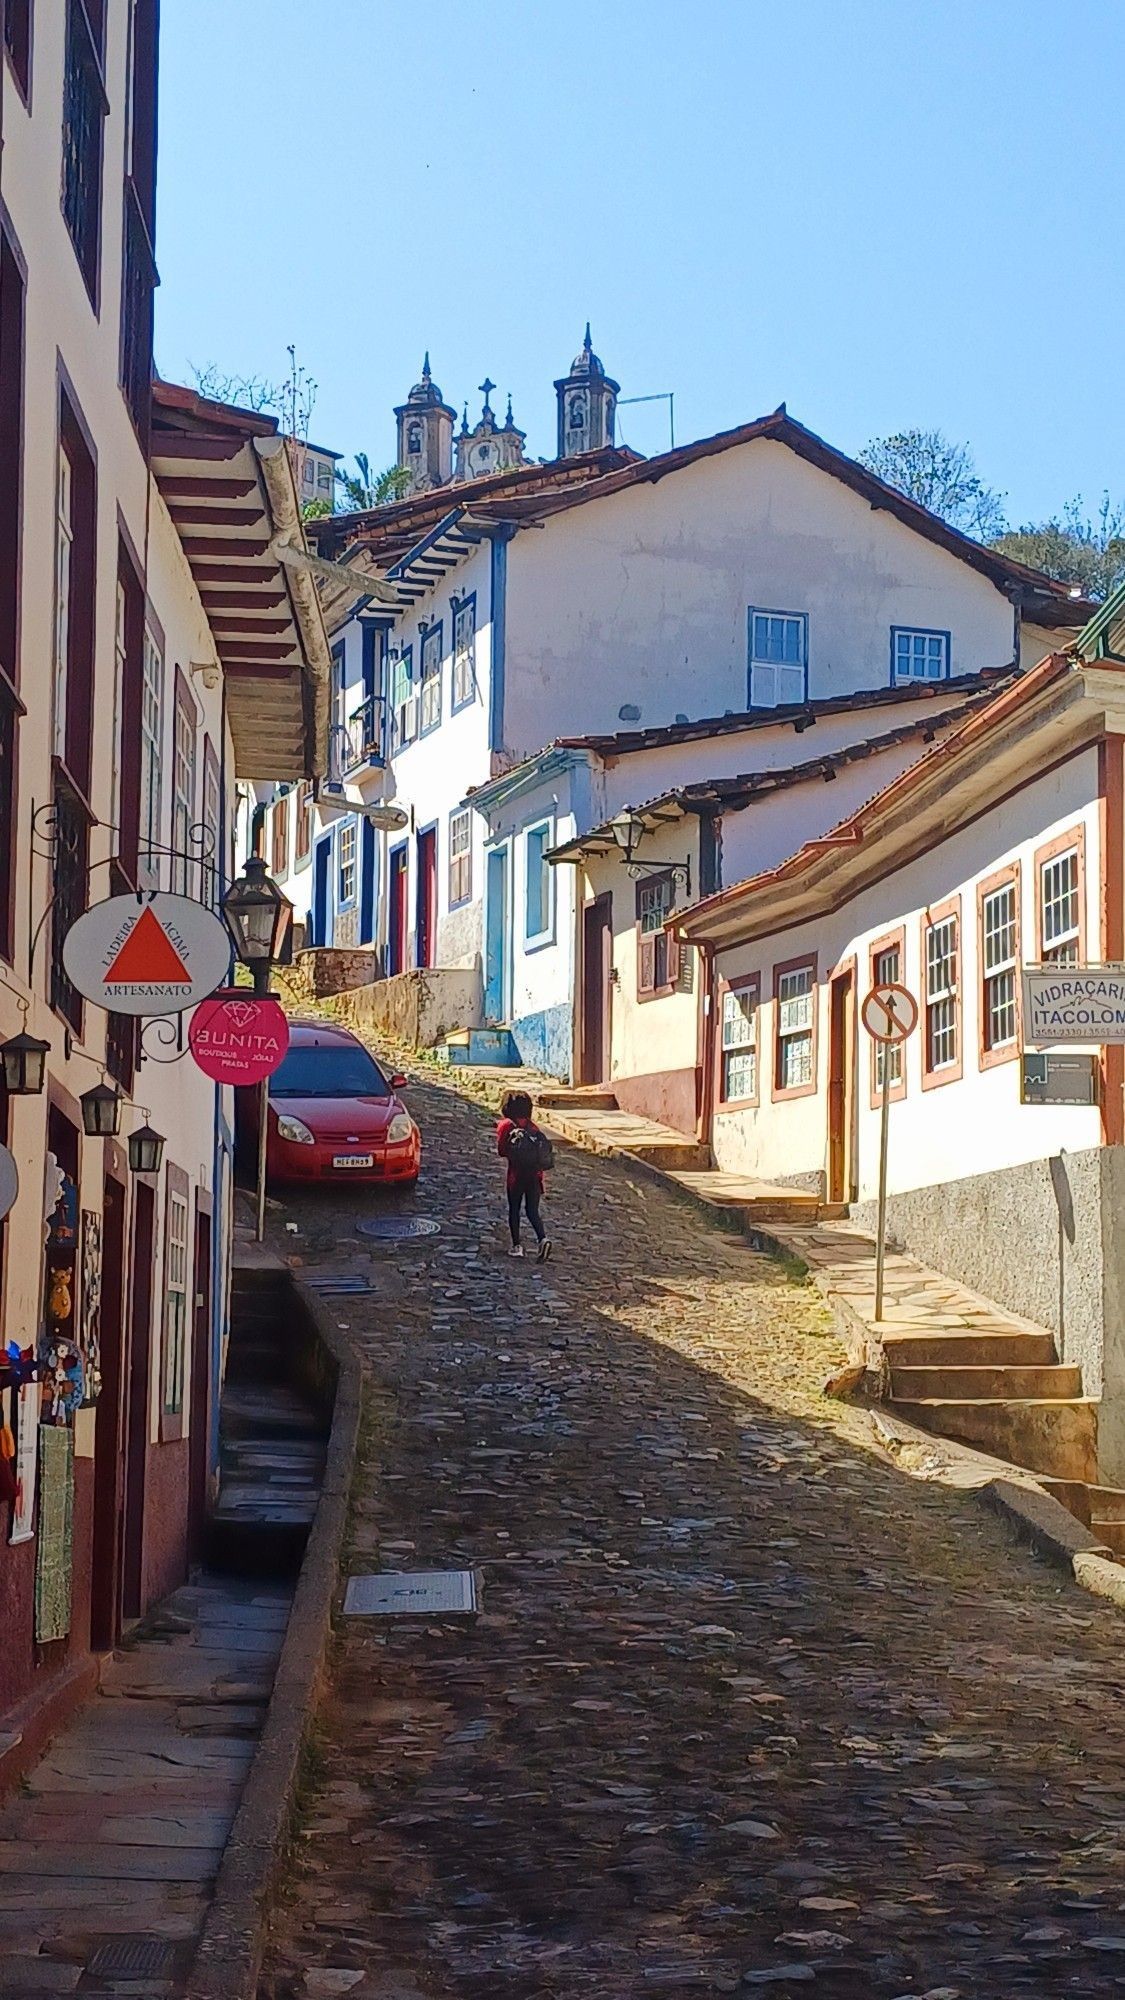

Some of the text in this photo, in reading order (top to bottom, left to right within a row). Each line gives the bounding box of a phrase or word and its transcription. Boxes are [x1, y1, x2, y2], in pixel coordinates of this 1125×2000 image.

[101, 916, 138, 967] LADEIRA
[161, 921, 190, 961] ACIMA
[104, 985, 192, 996] ARTESANATO
[1033, 980, 1125, 1007] VIDRAÇARI
[196, 1029, 279, 1051] BUNITA
[221, 1059, 249, 1069] PRATAS
